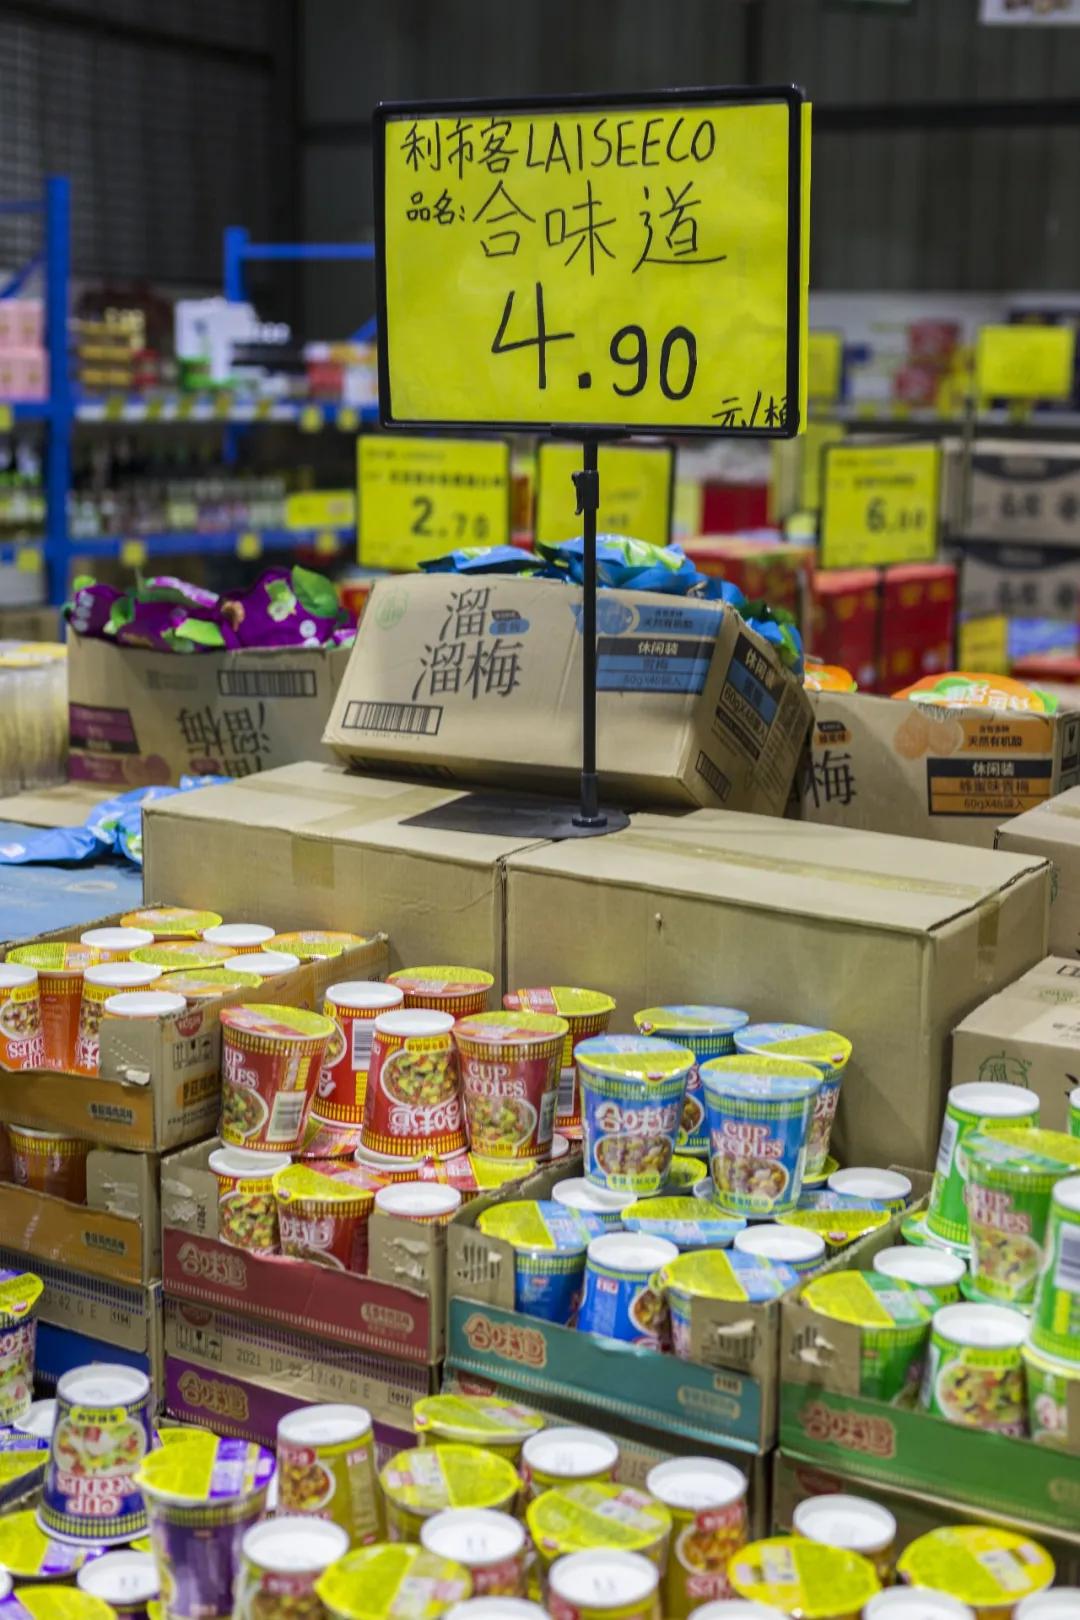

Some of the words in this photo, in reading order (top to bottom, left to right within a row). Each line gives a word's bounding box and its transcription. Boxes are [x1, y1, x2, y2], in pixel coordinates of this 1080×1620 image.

[472, 180, 727, 275] 合味道
[491, 282, 697, 400] 4.90
[224, 1045, 244, 1068] UP
[468, 1062, 508, 1082] CUP
[463, 1077, 526, 1099] OODLES
[723, 1120, 770, 1142] CUP
[710, 1129, 783, 1158] NOODLES
[281, 1216, 336, 1250] 味道
[236, 1347, 261, 1368] 2021
[66, 1496, 121, 1515] CUP
